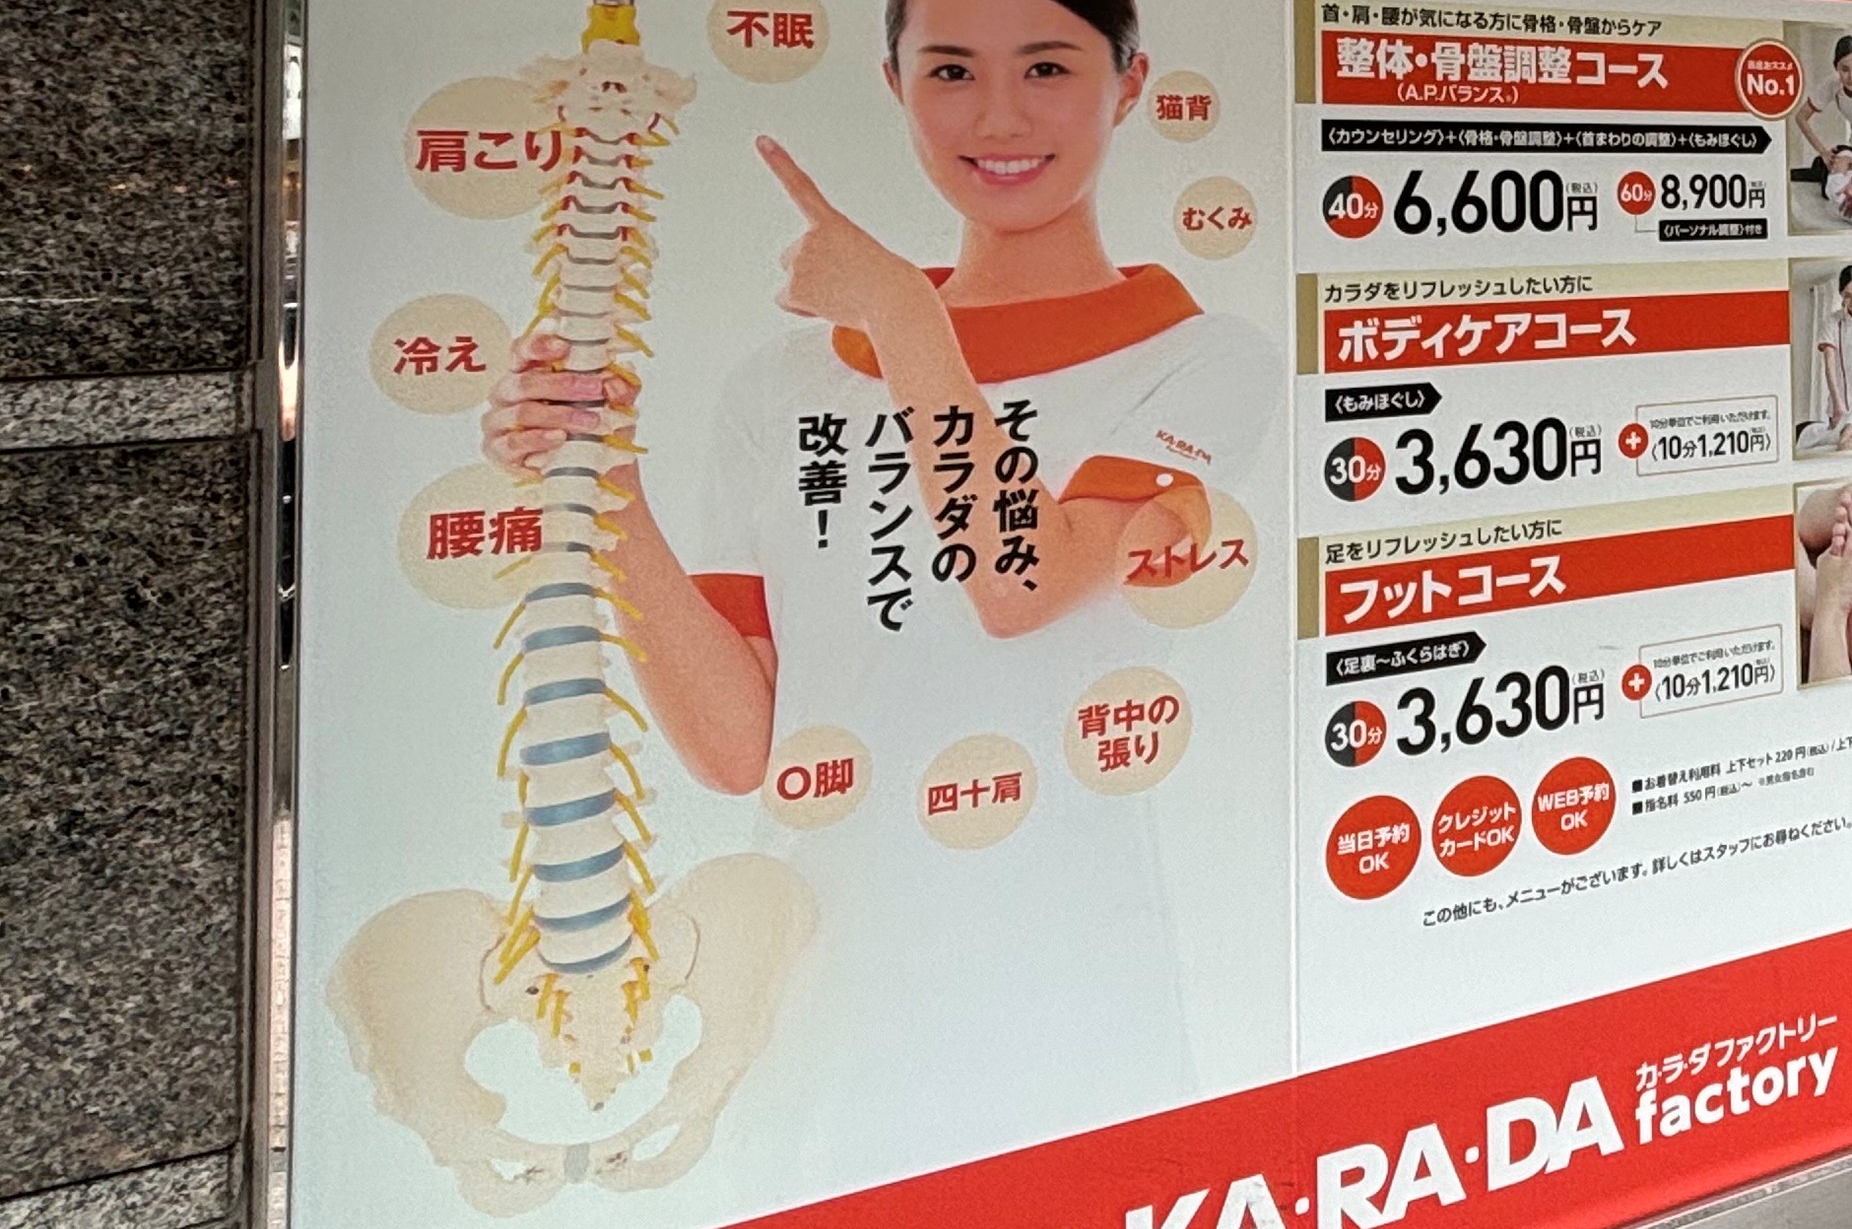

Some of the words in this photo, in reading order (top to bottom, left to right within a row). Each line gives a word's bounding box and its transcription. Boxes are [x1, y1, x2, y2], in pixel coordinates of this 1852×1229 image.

[726, 9, 815, 49] 不眠
[1336, 36, 1669, 90] 整体・骨盤調整コース
[1746, 73, 1795, 97] No.1
[1155, 93, 1212, 122] 猫背
[415, 128, 563, 174] 肩こり
[1328, 191, 1380, 220] 40分
[1393, 169, 1598, 237] 6,600円
[1620, 183, 1653, 203] 60分
[1661, 173, 1766, 211] 8,900円
[1180, 205, 1254, 234] むくみ
[1324, 274, 1594, 303] カラダをリフレッシュしたい方に
[392, 333, 488, 377] 冷え
[1337, 308, 1638, 363] ボディケアコース
[1330, 455, 1382, 486] 30分
[1395, 417, 1602, 497] 3,630円
[797, 412, 849, 549] 改善!
[932, 404, 977, 583] カラダの
[993, 398, 1039, 593] その悩み、
[426, 506, 543, 561] 腰痛
[866, 405, 915, 632] バランスで
[1125, 538, 1250, 588] ストレス
[1324, 519, 1563, 566] 足をリフレッシュしたい方に
[1340, 555, 1567, 624] フットコース
[1077, 694, 1180, 740] 背中の
[1330, 718, 1383, 752] 30分
[1396, 664, 1604, 756] 3,630円
[1096, 729, 1160, 774] 張り
[926, 771, 1023, 816] 四十肩
[1537, 782, 1611, 813] WEB予約
[1337, 822, 1411, 856] 当日予約
[1437, 801, 1517, 835] クレジット
[1560, 809, 1589, 832] OK
[1358, 851, 1390, 874] OK
[1438, 825, 1516, 858] カードOK
[1634, 1045, 1839, 1145] factory
